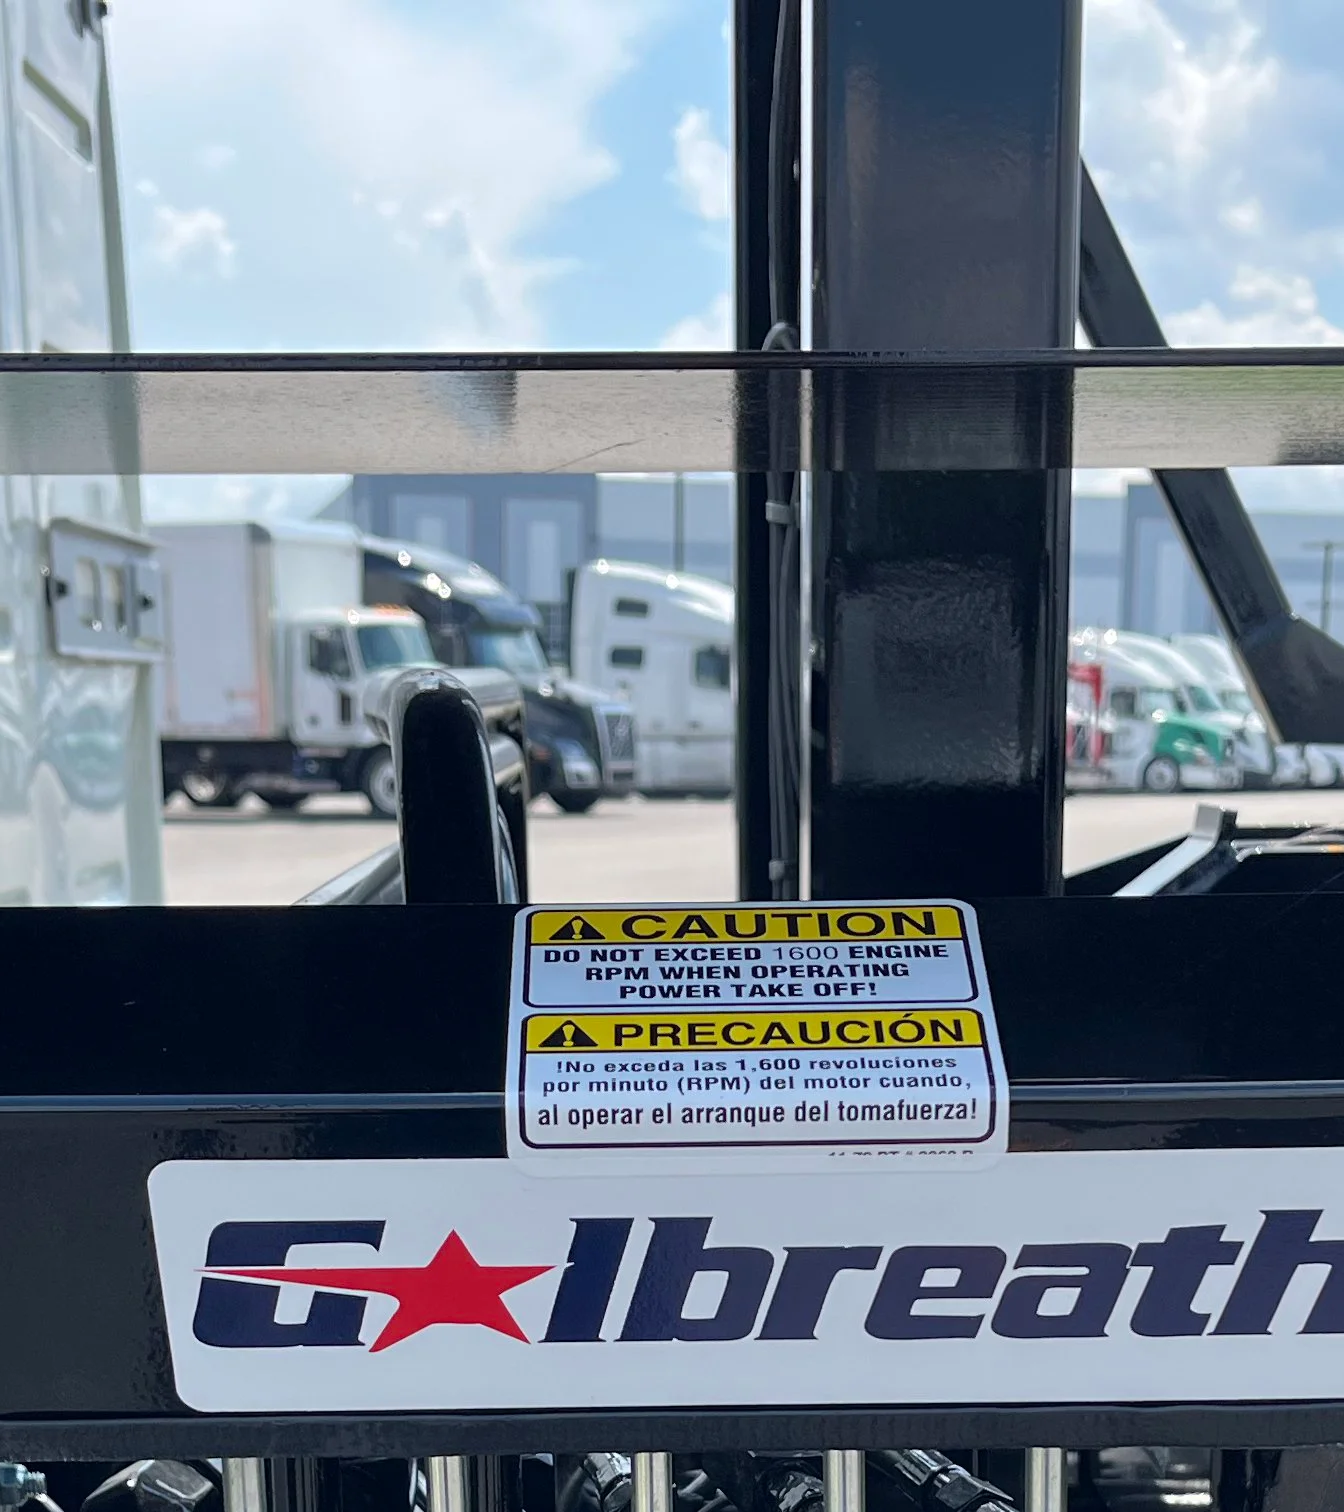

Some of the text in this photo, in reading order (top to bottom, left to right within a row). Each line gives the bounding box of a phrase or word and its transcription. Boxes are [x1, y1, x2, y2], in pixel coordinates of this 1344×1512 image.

[621, 911, 936, 940] CAUTION
[544, 943, 950, 963] DO NOT EXCEED 1600 ENGINE
[586, 962, 910, 981] RPM WHEN OPERATING
[619, 981, 878, 1000] POWER TAKE OFF!
[613, 1013, 965, 1048] PRECAUCIÓN
[604, 1059, 685, 1074] exceda
[694, 1058, 728, 1072] las
[735, 1057, 801, 1073] 1,600
[808, 1056, 957, 1071] revoluciones
[542, 1073, 972, 1096] por minuto (RPM) del motor cuando,
[537, 1098, 978, 1130] al operar el arranque del tomafuerza!
